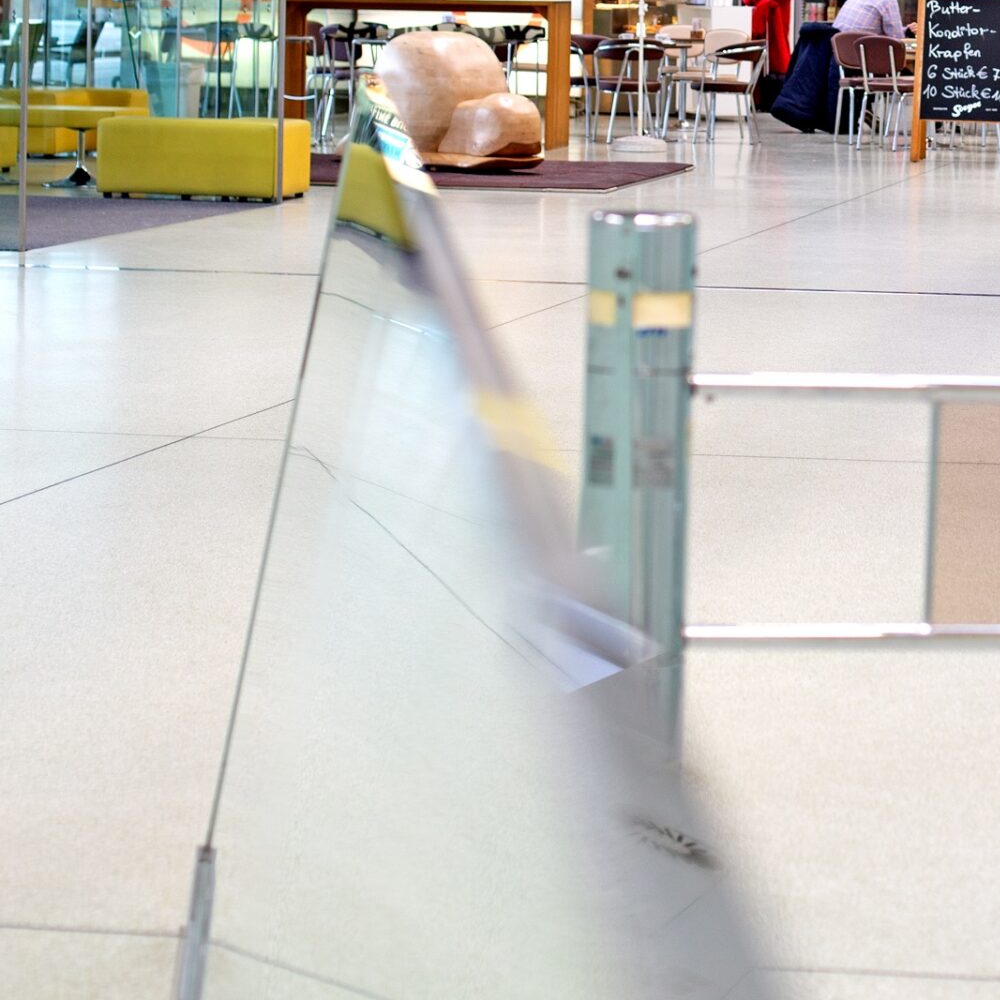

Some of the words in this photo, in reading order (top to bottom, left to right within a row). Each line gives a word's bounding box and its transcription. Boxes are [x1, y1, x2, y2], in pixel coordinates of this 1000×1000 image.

[927, 0, 980, 18] Butter-
[928, 21, 997, 39] Konditor-
[928, 42, 981, 62] Krapfen
[927, 64, 937, 79] 6
[942, 65, 975, 80] Stück
[923, 84, 937, 99] 10
[941, 84, 980, 99] Stück
